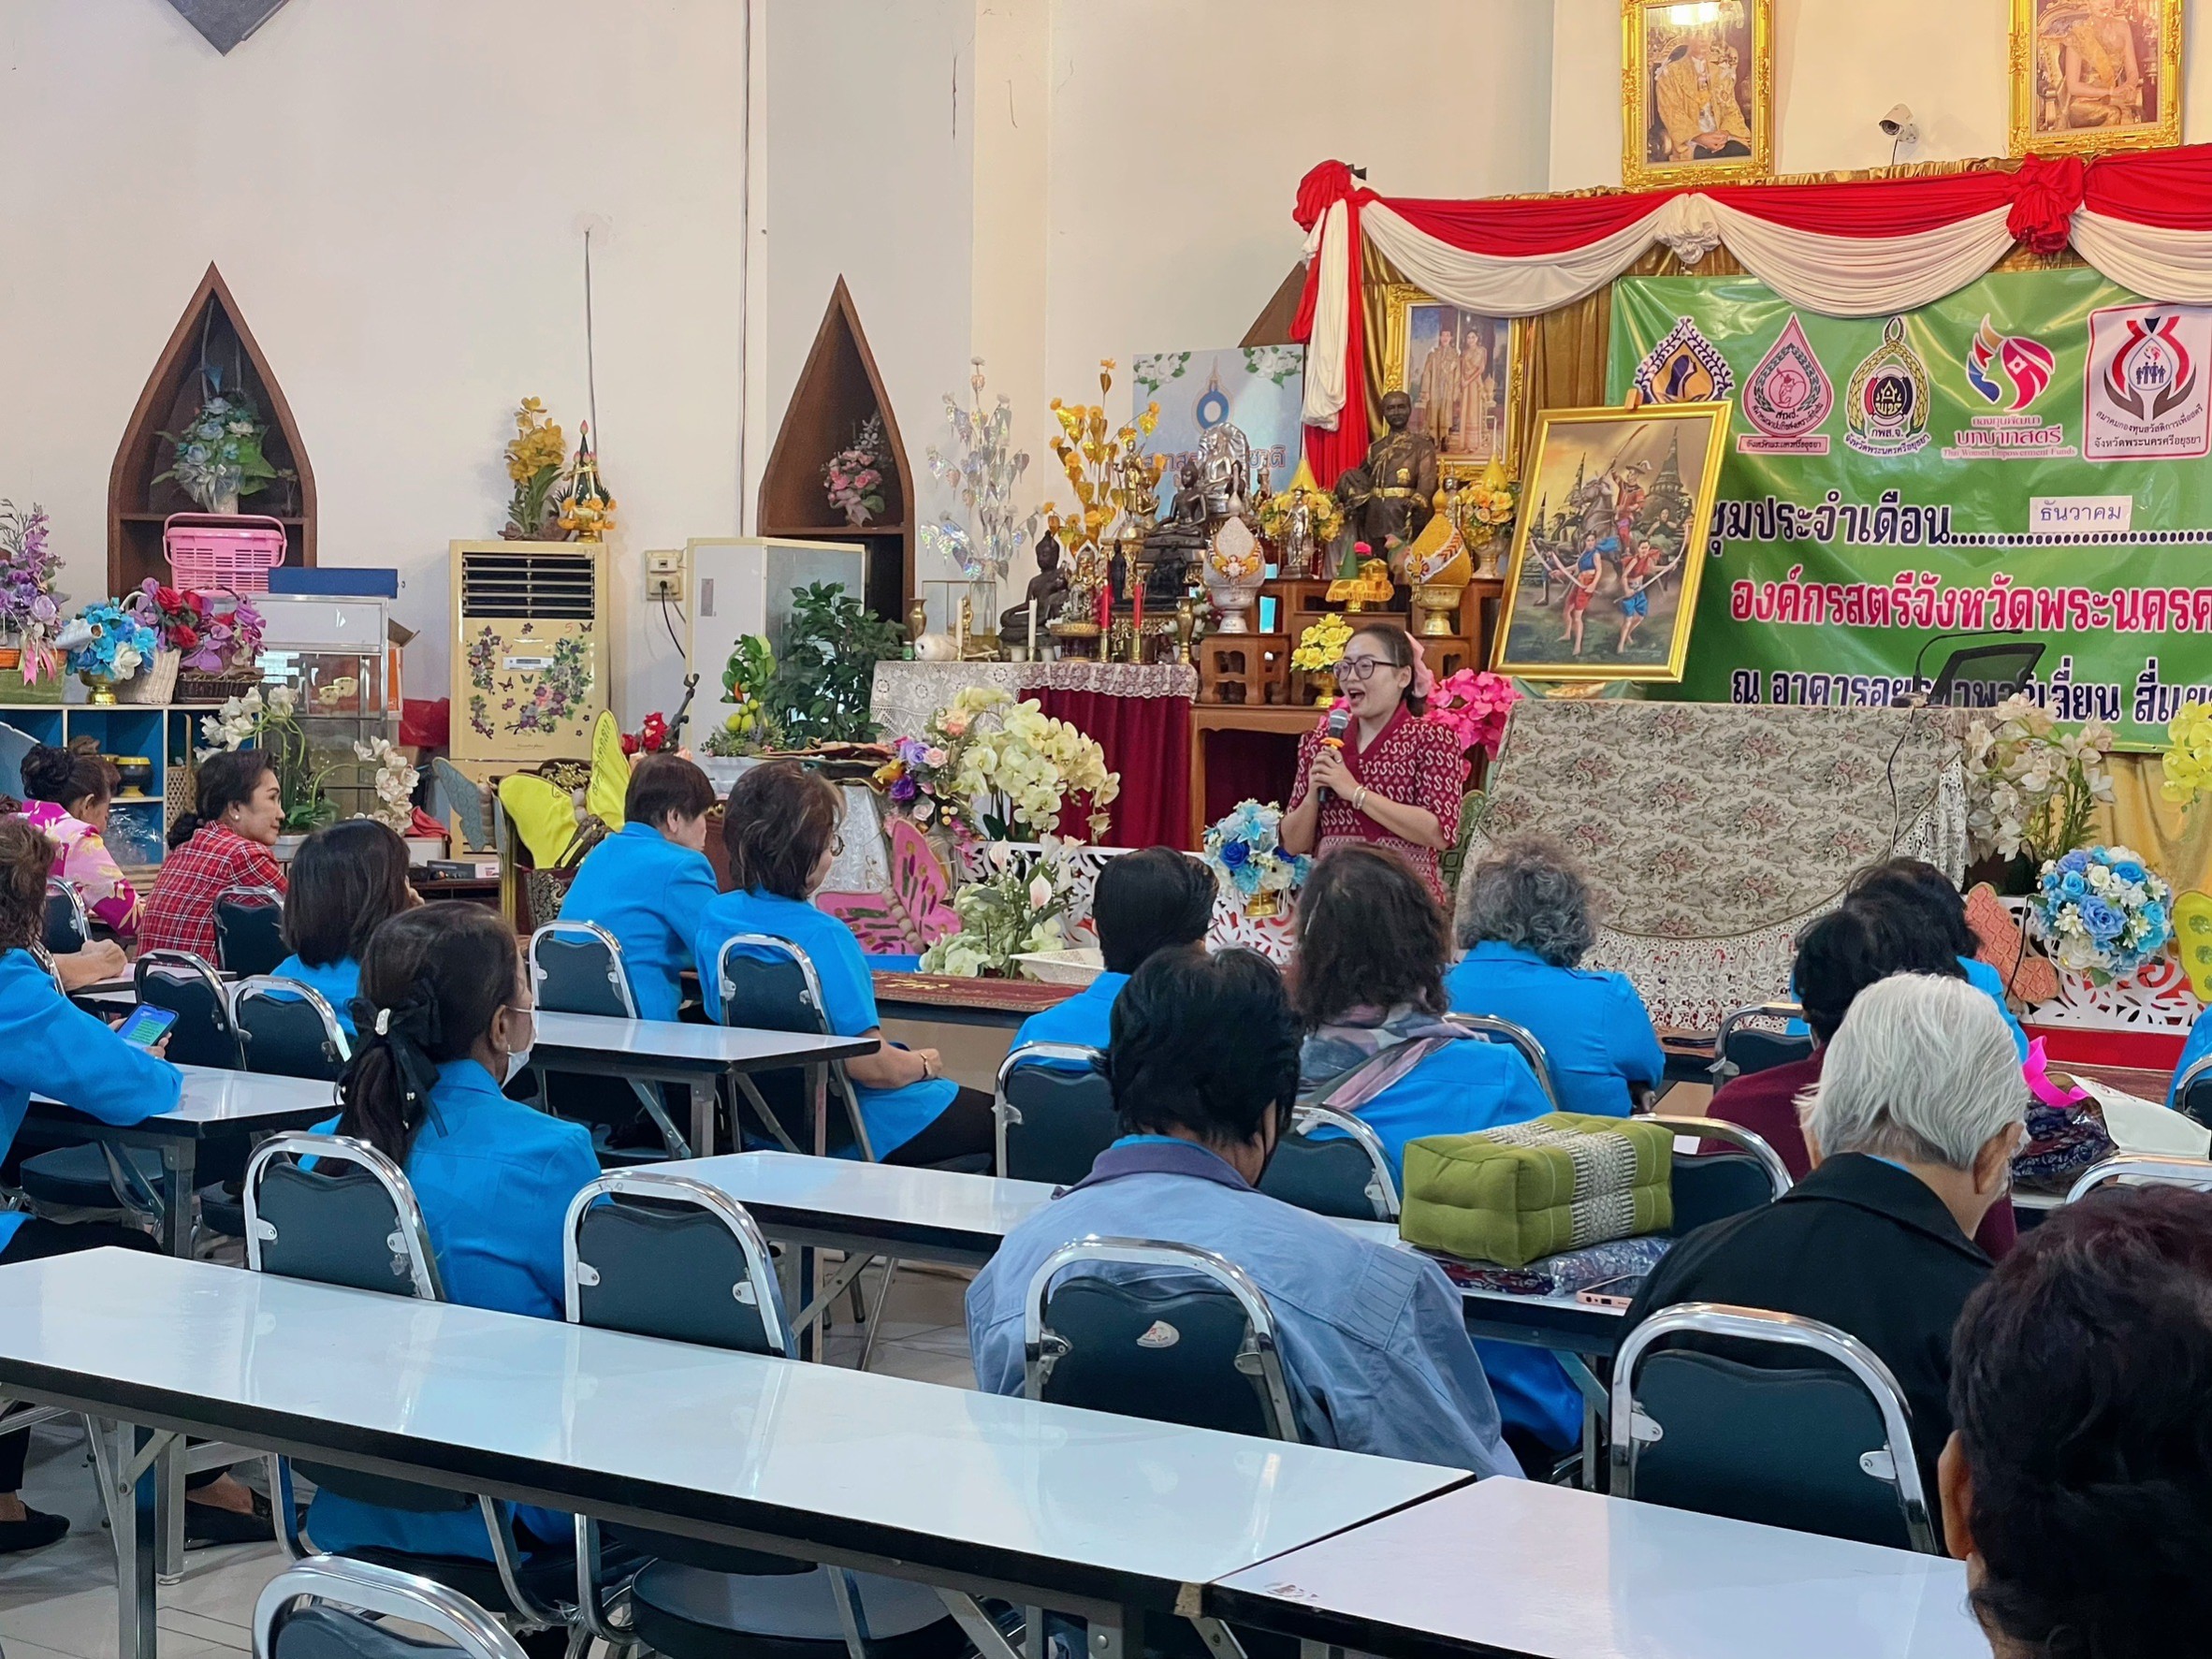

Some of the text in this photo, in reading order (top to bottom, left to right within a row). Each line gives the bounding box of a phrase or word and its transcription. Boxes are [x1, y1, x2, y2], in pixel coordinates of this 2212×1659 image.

[2094, 434, 2201, 448] จังหวัดพระนครศรีอยุธยา
[1991, 448, 2048, 458] Empowerment
[2051, 447, 2075, 456] Funds
[2040, 499, 2122, 522] ธันวาคม
